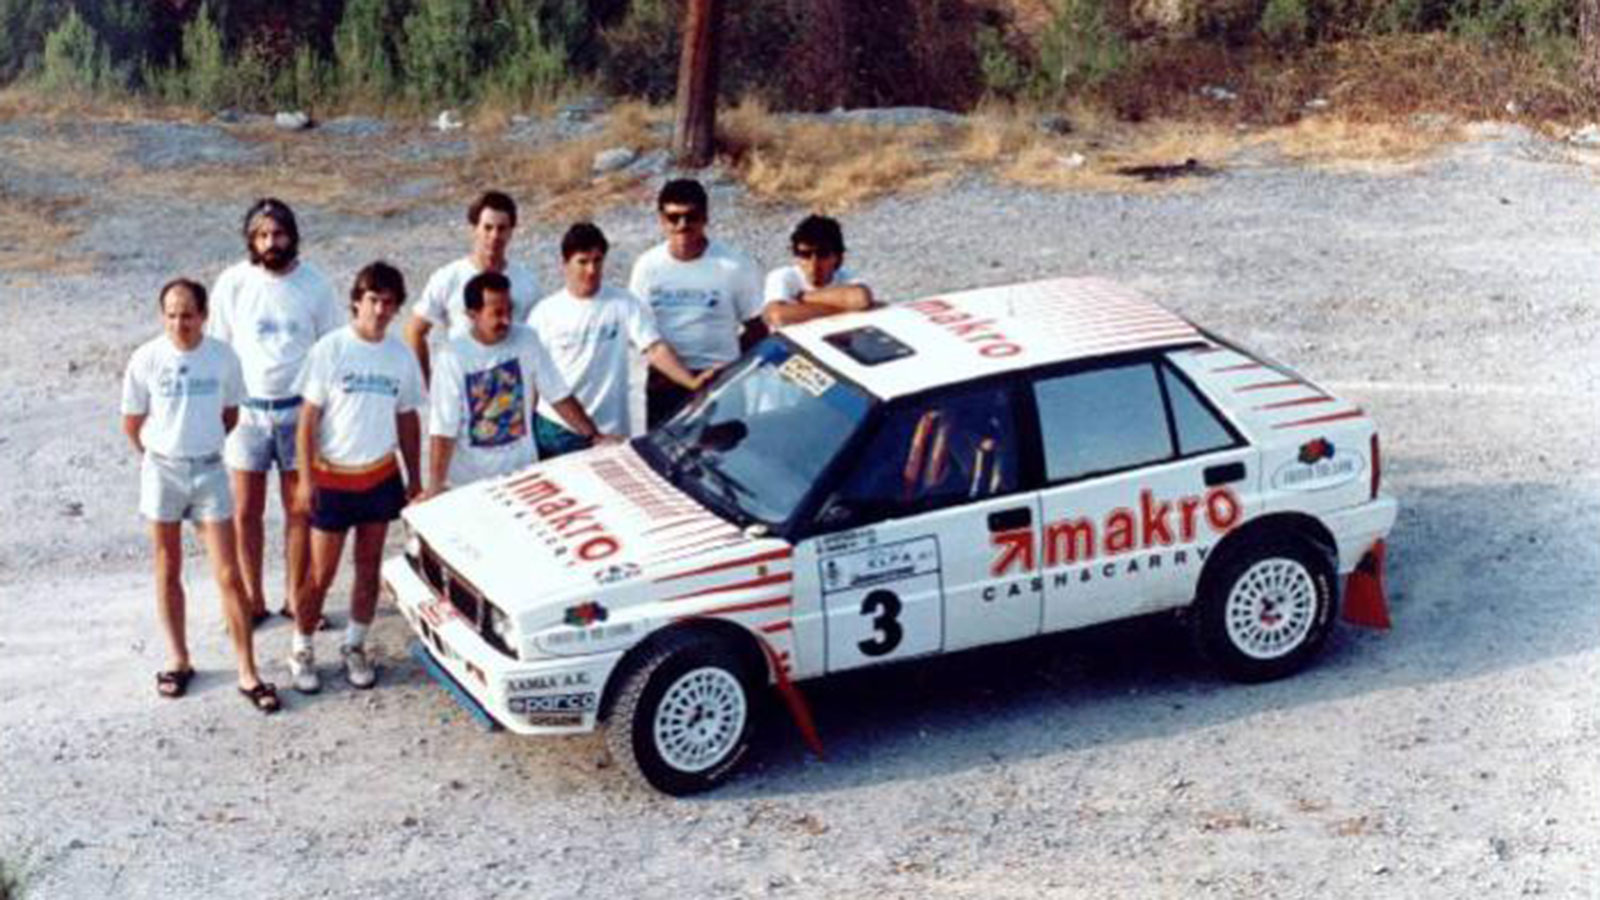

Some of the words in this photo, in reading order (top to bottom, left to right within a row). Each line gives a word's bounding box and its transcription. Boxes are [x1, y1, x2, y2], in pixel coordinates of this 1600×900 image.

[902, 299, 1022, 358] makro
[514, 478, 620, 561] makro
[1043, 487, 1242, 567] makro
[982, 547, 1208, 601] CASH&CARRY
[857, 588, 904, 657] 3
